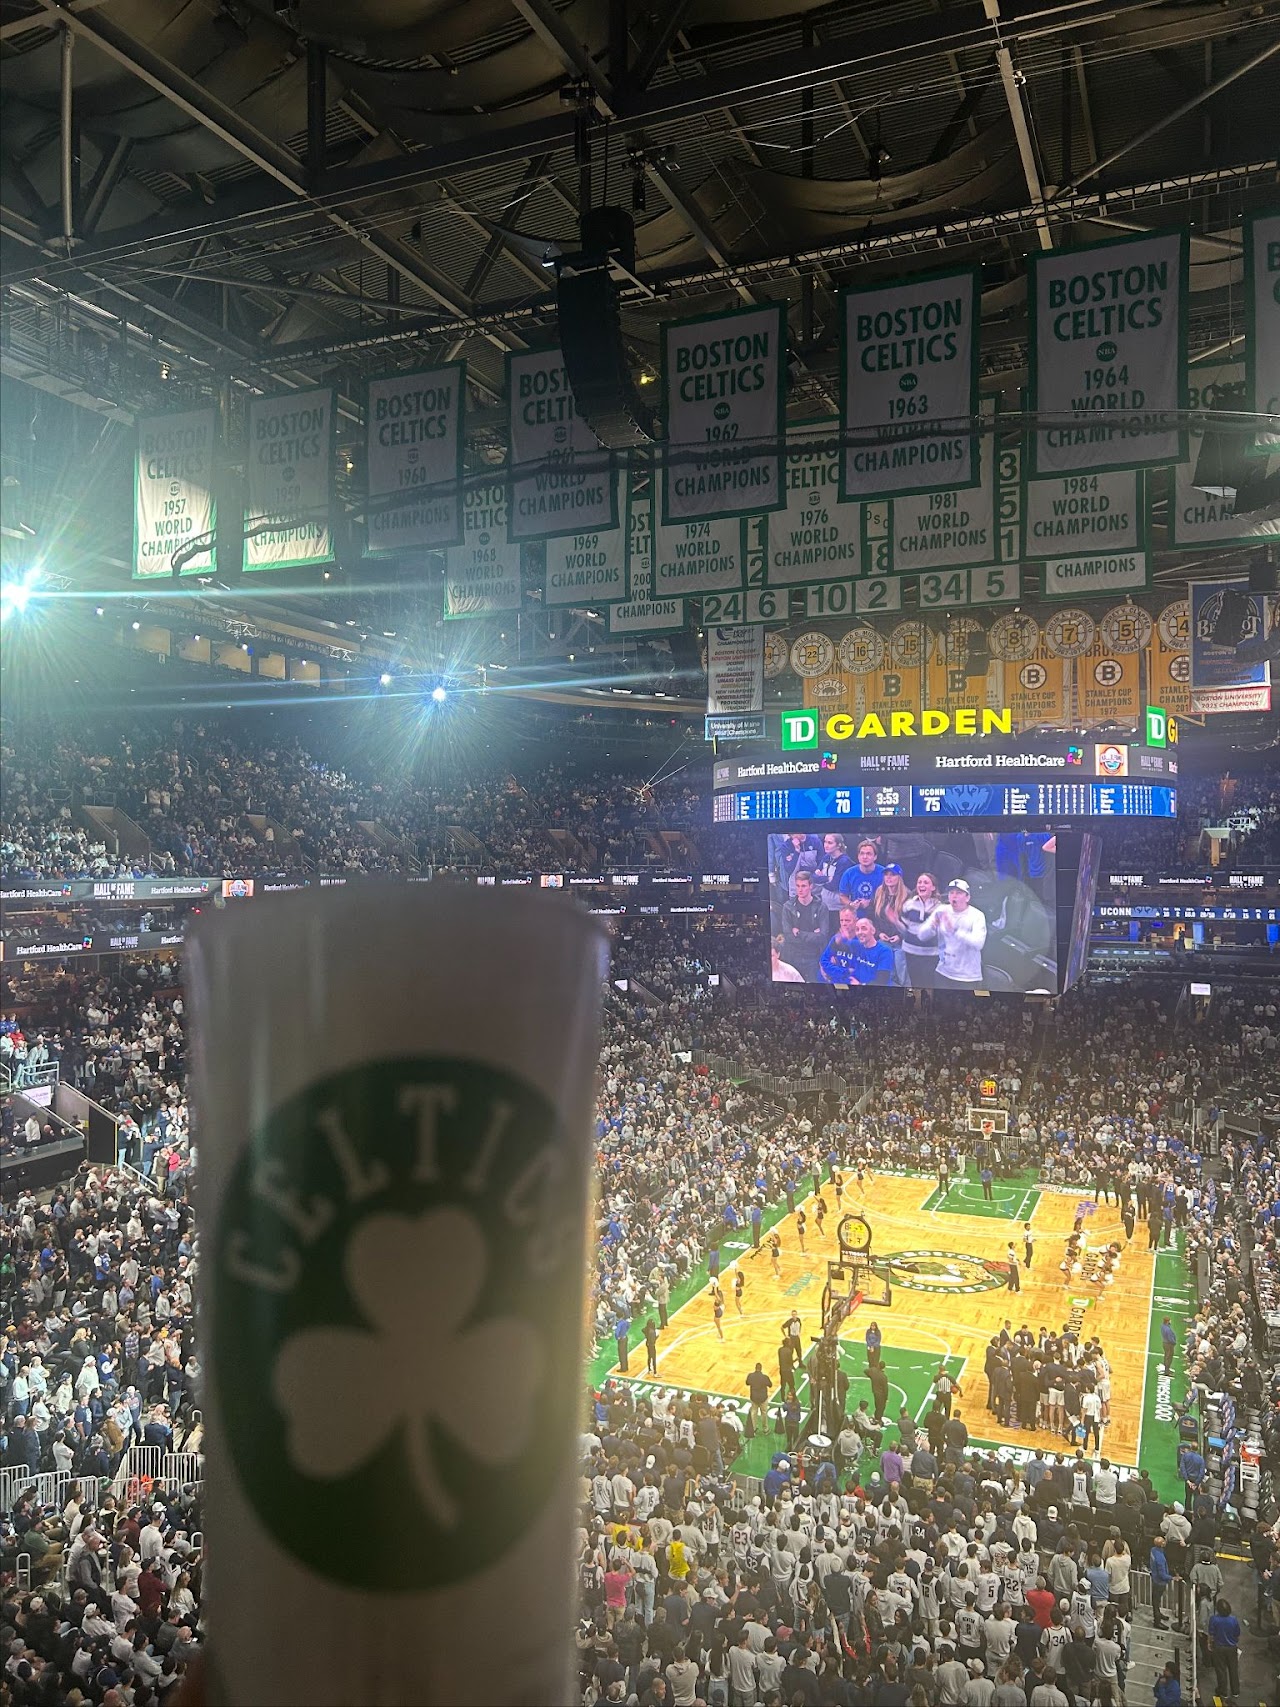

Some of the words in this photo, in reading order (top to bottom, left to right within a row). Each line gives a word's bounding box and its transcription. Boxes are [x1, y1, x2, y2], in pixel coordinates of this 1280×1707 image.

[1049, 261, 1168, 309] BOSTON
[857, 298, 962, 342] BOSTON
[1053, 297, 1162, 342] CELTICS
[676, 332, 769, 373] BOSTON
[860, 332, 958, 373] CELTICS
[519, 369, 568, 398] BOST
[679, 364, 765, 402] CELTICS
[1084, 364, 1129, 391] 1964
[376, 386, 451, 421] BOSTON
[523, 395, 573, 426] CELTI
[888, 395, 928, 419] 1963
[1071, 389, 1146, 420] WORLD
[256, 409, 324, 442] BOSTON
[378, 414, 448, 448] CELTICS
[705, 423, 739, 442] 1962
[258, 435, 321, 466] CELTICS
[854, 440, 963, 474] CHAMPIONS
[398, 466, 426, 486] 1960
[674, 465, 771, 497] CHAMPIONS
[1063, 476, 1098, 495] 1984
[464, 486, 504, 508] OSTO
[518, 487, 603, 516] CHAMPIONS
[929, 492, 957, 510] 1981
[164, 499, 187, 517] 1957
[1053, 496, 1110, 516] WORLD
[800, 509, 828, 526] 1976
[918, 511, 970, 531] WORLD
[1033, 513, 1129, 537] CHAMPIONS
[155, 517, 193, 537] WORLD
[252, 522, 323, 547] CHAMPIONS
[684, 522, 711, 539] 1974
[573, 535, 598, 551] 1969
[790, 527, 838, 547] WORLD
[899, 529, 986, 553] CHAMPIONS
[471, 548, 497, 563] 1968
[676, 540, 720, 559] WORLD
[774, 543, 855, 567] CHAMPIONS
[565, 553, 607, 570] WORLD
[660, 555, 735, 579] CHAMPIONS
[1056, 558, 1136, 578] CHAMPIONS
[551, 567, 619, 588] CHAMPIONS
[986, 571, 1005, 598] 5
[868, 580, 888, 609] 2
[923, 573, 963, 604] 34
[758, 591, 776, 618] 6
[811, 584, 847, 613] 10
[616, 601, 676, 620] CHAMPIONS
[704, 595, 741, 623] 24
[1010, 631, 1019, 644] 8
[1065, 628, 1074, 641] 7
[1120, 624, 1131, 636] 5
[807, 650, 817, 658] 22
[856, 646, 866, 657] 16
[905, 640, 917, 652] 15
[1102, 665, 1115, 680] B
[813, 680, 847, 694] BOSTON
[1085, 689, 1117, 698] STANLEY
[1118, 689, 1132, 698] CUP
[900, 700, 912, 708] CUP
[966, 695, 979, 704] CUP
[1011, 692, 1041, 701] STANLEY
[1043, 691, 1056, 700] CUP
[1085, 698, 1132, 707] CHAMPIONS
[1160, 695, 1190, 704] CHAMP
[1219, 700, 1259, 708] CHAMPIONS
[1224, 693, 1262, 701] UNIVERSITY
[1010, 701, 1056, 710] CHAMPIONS
[1100, 707, 1118, 716] 1972
[711, 721, 737, 731] University
[785, 716, 815, 741] TD
[826, 708, 1012, 740] GARDEN
[737, 763, 765, 777] Hartford
[766, 761, 820, 774] HealthCare
[860, 756, 880, 767] HALL
[887, 754, 910, 766] FAME
[935, 754, 993, 767] Hartford
[995, 754, 1065, 767] HealthCare
[876, 793, 899, 805] 3:53
[919, 788, 946, 796] UCONN
[835, 799, 850, 814] 70
[923, 797, 941, 811] 75
[26, 889, 62, 898] HealthCare
[94, 883, 111, 895] HALL
[117, 883, 135, 895] FAME
[151, 886, 173, 894] Hartford
[174, 885, 201, 893] HealthCare
[1100, 907, 1131, 916] UCONN
[17, 945, 45, 955] Hartford
[46, 943, 83, 953] HealthCare
[110, 938, 122, 946] HALL
[126, 936, 139, 944] FAME
[903, 1250, 984, 1263] BOSTON
[901, 1280, 988, 1293] CELTICS
[734, 1531, 747, 1545] 23
[915, 1527, 925, 1539] 34
[922, 1585, 930, 1598] 12
[988, 1586, 994, 1598] 5
[1006, 1578, 1018, 1591] 22
[1052, 1635, 1065, 1646] 34
